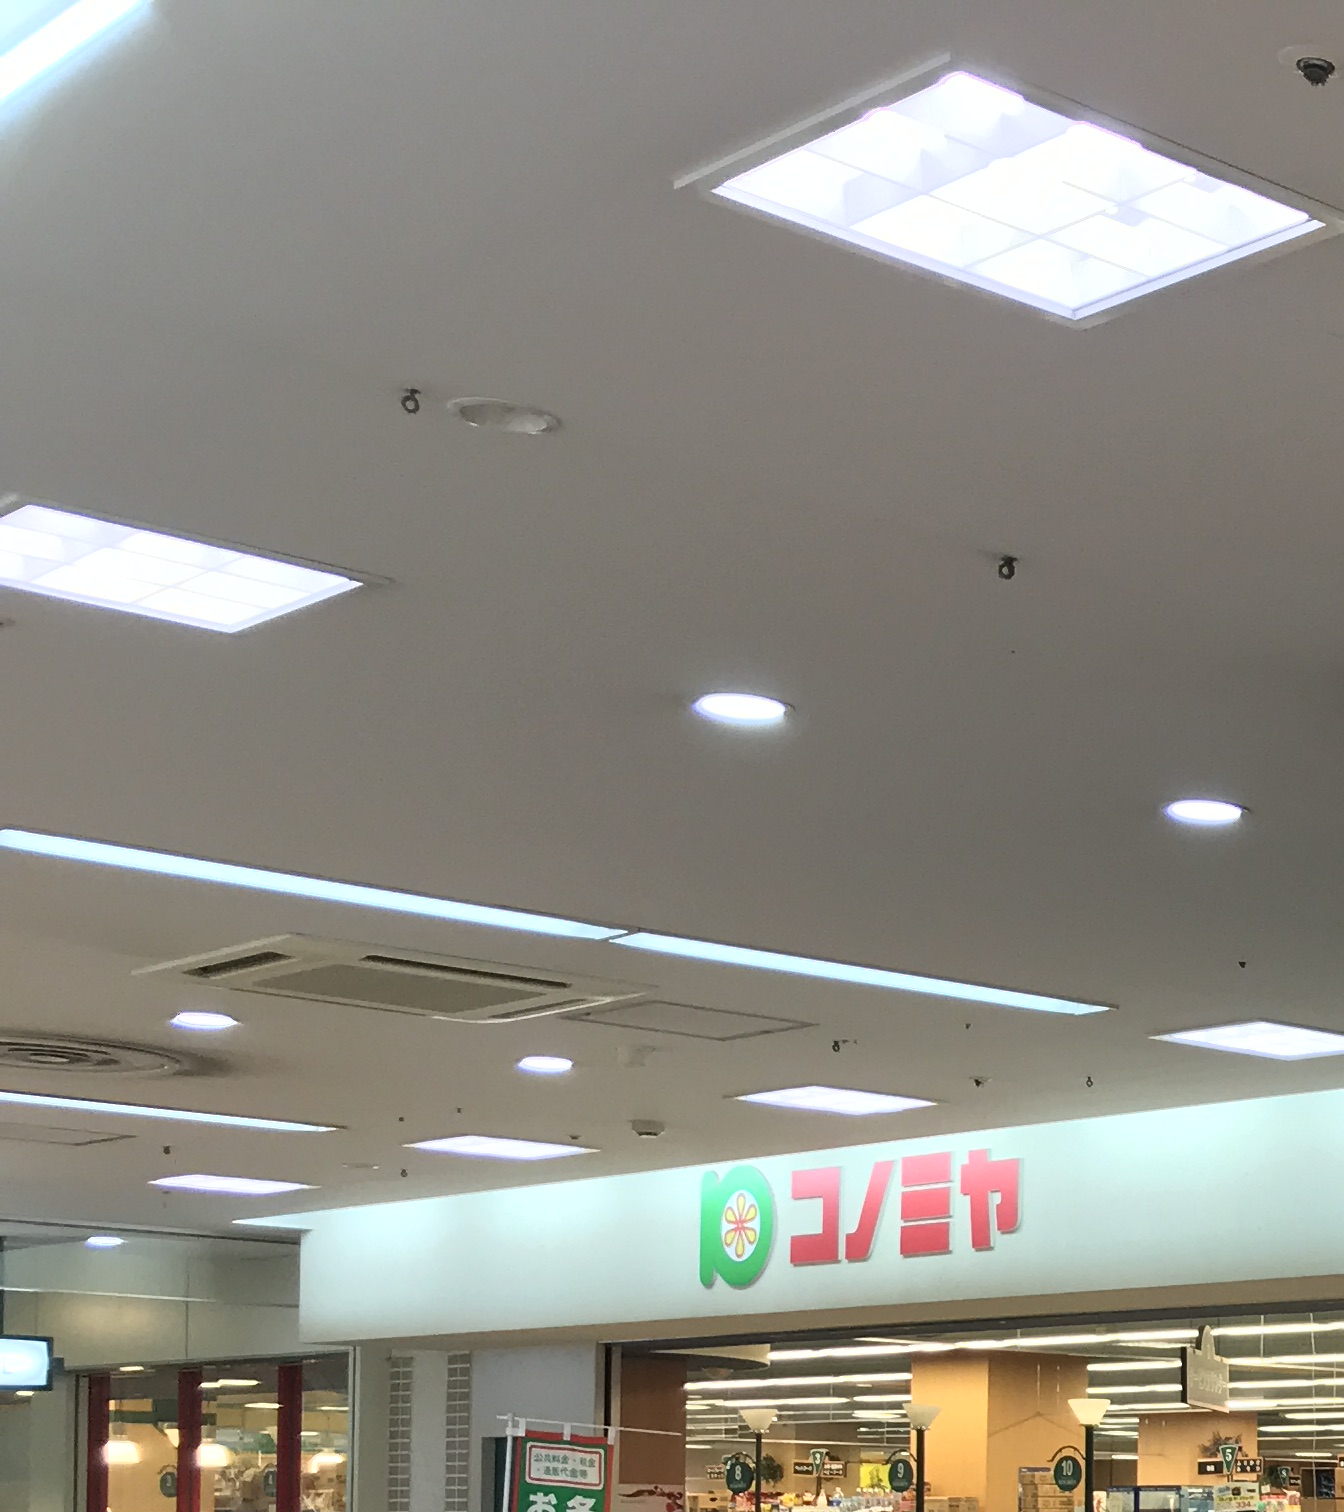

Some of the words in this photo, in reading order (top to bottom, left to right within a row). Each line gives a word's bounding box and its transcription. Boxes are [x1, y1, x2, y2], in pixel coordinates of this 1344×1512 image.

[790, 1149, 1020, 1265] コノミヤ
[1225, 1449, 1232, 1459] 5
[735, 1465, 742, 1481] 8
[896, 1462, 904, 1478] 9
[1061, 1459, 1073, 1476] 10
